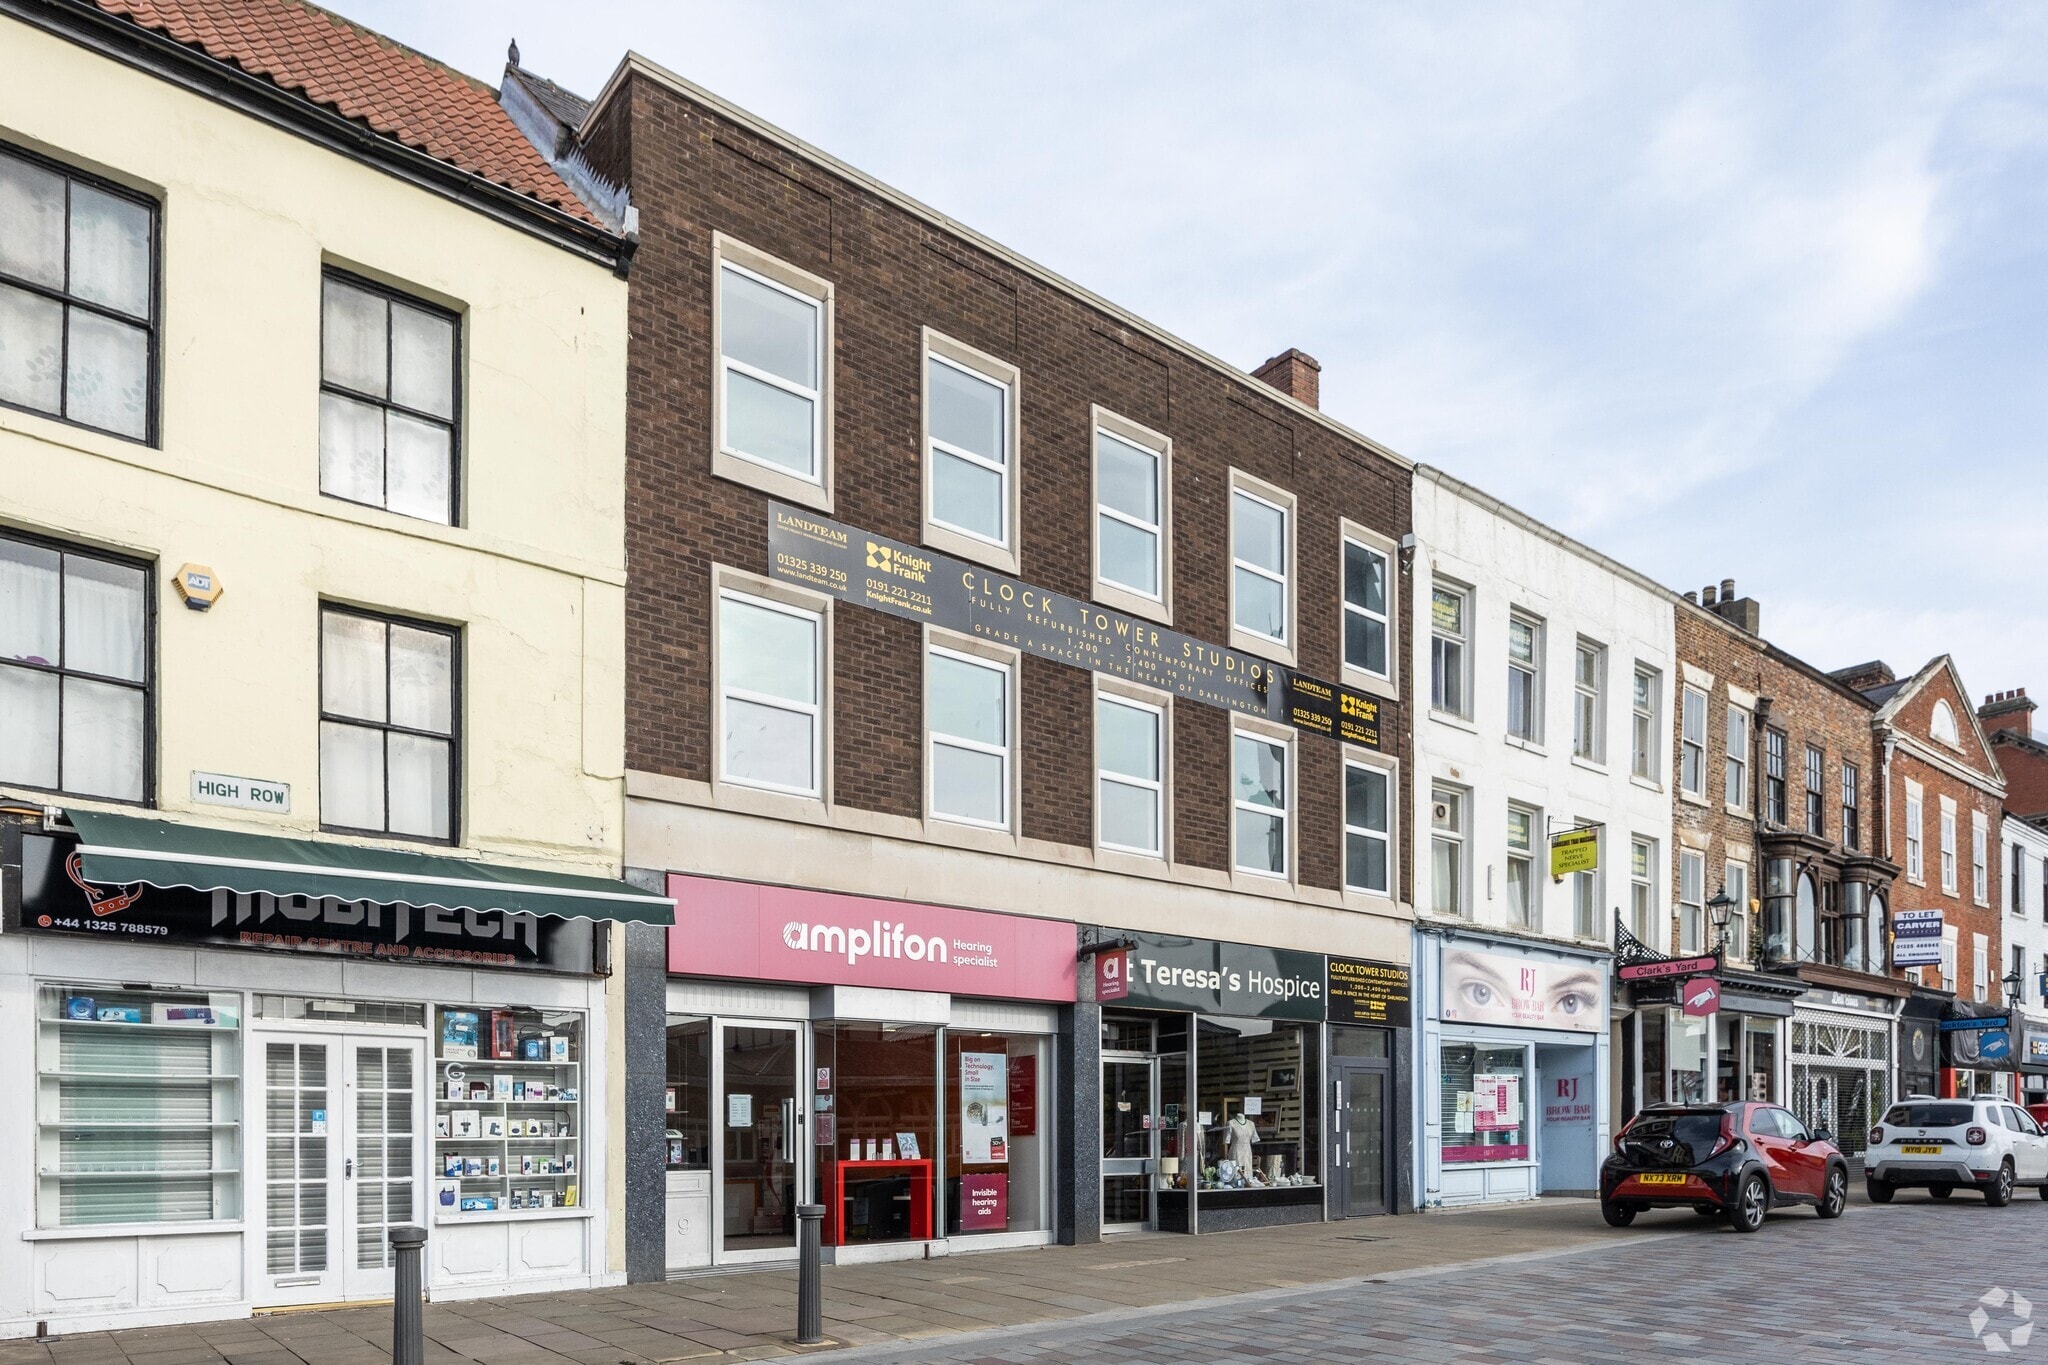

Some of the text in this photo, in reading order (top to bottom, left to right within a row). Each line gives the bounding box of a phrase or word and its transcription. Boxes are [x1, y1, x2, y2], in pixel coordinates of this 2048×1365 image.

[777, 512, 848, 543] LANDTEAM
[777, 553, 847, 582] 01325 339 250
[893, 550, 932, 573] Knight
[188, 575, 210, 588] ADT
[777, 565, 848, 592] www.landteam.co.uk
[893, 564, 926, 583] Frank
[866, 578, 932, 605] 0191 221 2211
[866, 589, 932, 615] KnightFrank.co.uk
[962, 572, 1274, 684] CLOCK TOWER STUDIOS
[972, 597, 1011, 615] FULLY
[1027, 613, 1112, 645] REFURBISHED
[1125, 643, 1214, 677] CONTEMPORARY
[1225, 674, 1268, 694] OFFICES
[975, 624, 1266, 714] GRADE A SPACE IN THE HEART OF DARLINGTON
[1067, 638, 1098, 653] 1,200
[1126, 655, 1156, 671] 2,400
[1167, 669, 1177, 679] sq
[1187, 674, 1195, 682] ft
[1293, 678, 1331, 696] LANDTEAM
[1356, 698, 1378, 713] Knight
[1293, 707, 1332, 726] 01325 339 250
[1356, 709, 1375, 721] Frank
[1341, 720, 1354, 731] 0191
[1355, 724, 1364, 734] 221
[199, 781, 284, 804] HIGH ROW
[1561, 846, 1587, 855] TRAPPED
[1565, 853, 1583, 861] NERVE
[1558, 858, 1590, 868] SPECIALIST
[54, 918, 168, 936] +44 1325 788579
[1897, 921, 1940, 930] CARVER
[240, 931, 516, 966] REPAIR CENTRE AND ACCESSORIES
[782, 920, 948, 966] amplifon
[953, 939, 993, 955] Hearing
[953, 955, 998, 968] specialist
[1637, 961, 1698, 976] Clark's Yard
[1330, 962, 1409, 980] CLOCK TOWER STUDIOS
[1140, 959, 1241, 992] Teresa's
[1249, 970, 1320, 1002] Hospice
[1520, 968, 1536, 998] RJ
[1532, 999, 1545, 1012] BAR
[1557, 1078, 1579, 1102] RJ
[1546, 1104, 1590, 1115] BROW BAR
[1643, 1174, 1683, 1182] NX73 XRM
[972, 1188, 998, 1197] Invisible
[972, 1199, 998, 1207] hearing
